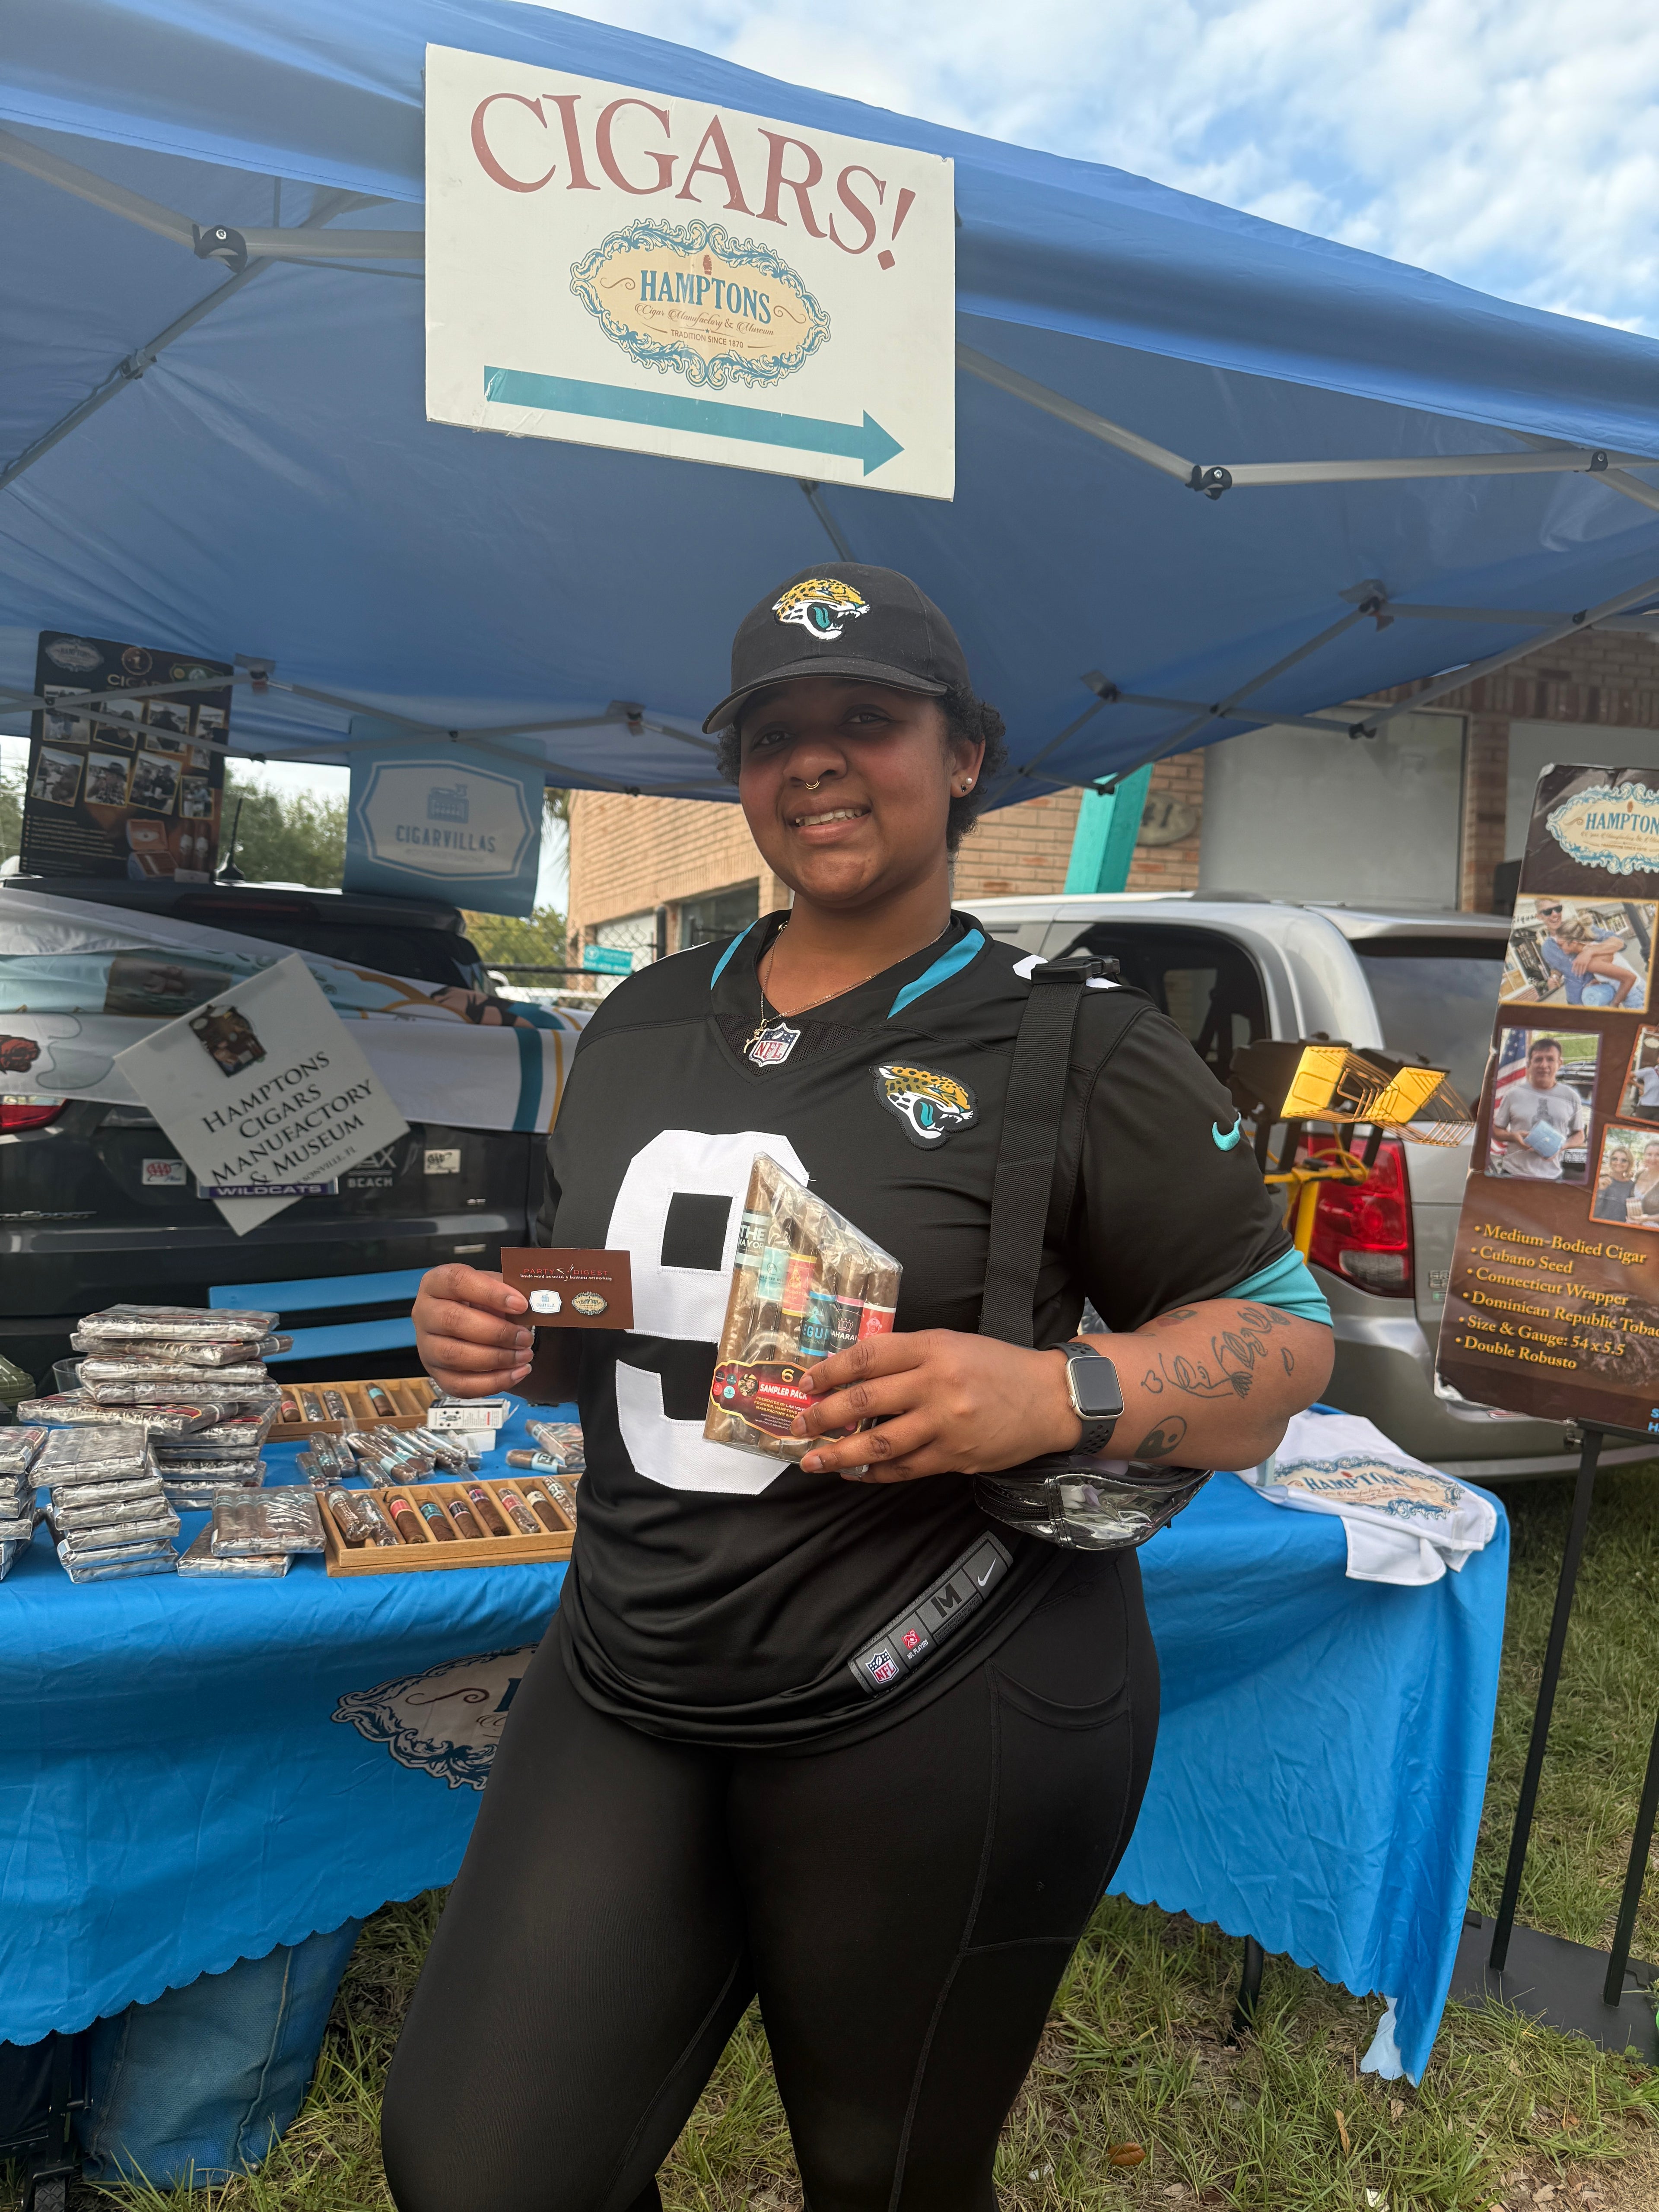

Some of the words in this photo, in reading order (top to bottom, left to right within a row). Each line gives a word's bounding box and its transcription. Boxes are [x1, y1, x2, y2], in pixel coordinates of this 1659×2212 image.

[471, 92, 916, 270] CIGARS!
[640, 270, 771, 324] HAMPTONS
[635, 303, 664, 320] Cigar
[668, 309, 724, 331] Manufactory
[725, 318, 734, 329] &
[736, 321, 774, 336] Museum
[671, 329, 706, 342] TRADITION
[708, 336, 727, 346] SINCE
[728, 340, 744, 348] 1870
[1585, 813, 1659, 836] HAMPTON
[395, 825, 496, 853] CIGARVILLAS
[757, 1041, 782, 1060] NFL
[202, 1051, 330, 1134] HAMPTONS
[239, 1084, 322, 1138] CIGARS
[210, 1079, 373, 1185] MANUFACTORY
[251, 1170, 272, 1185] &
[271, 1114, 364, 1177] MUSEUM
[217, 1185, 321, 1195] WILDCATS
[347, 1177, 393, 1188] BEACH
[740, 1224, 767, 1241] THE
[1483, 1224, 1602, 1257] Medium-Bodied
[1605, 1244, 1647, 1265] Cigar
[1480, 1245, 1536, 1268] Cubano
[1539, 1255, 1573, 1274] Seed
[1476, 1267, 1563, 1294] Connecticut
[1566, 1282, 1629, 1306] Wrapper
[1471, 1290, 1550, 1318] Dominican
[1554, 1306, 1617, 1329] Republic
[1620, 1317, 1659, 1338] Tobac
[803, 1324, 830, 1341] EGU
[1467, 1315, 1497, 1332] Size
[1499, 1321, 1515, 1336] &
[1518, 1325, 1568, 1348] Gauge:
[1570, 1335, 1589, 1351] 54
[1598, 1341, 1626, 1357] 5.5
[1464, 1335, 1516, 1358] Double
[1518, 1346, 1578, 1370] Robusto
[782, 1368, 795, 1382] 6
[756, 1396, 779, 1405] PRESENTED
[760, 1383, 790, 1397] SAMPLER
[790, 1389, 807, 1400] PACK
[756, 1406, 785, 1416] MANUFACTORY
[775, 1406, 797, 1414] HAMPTONS
[930, 1583, 963, 1618] M
[874, 1661, 896, 1681] NFL
